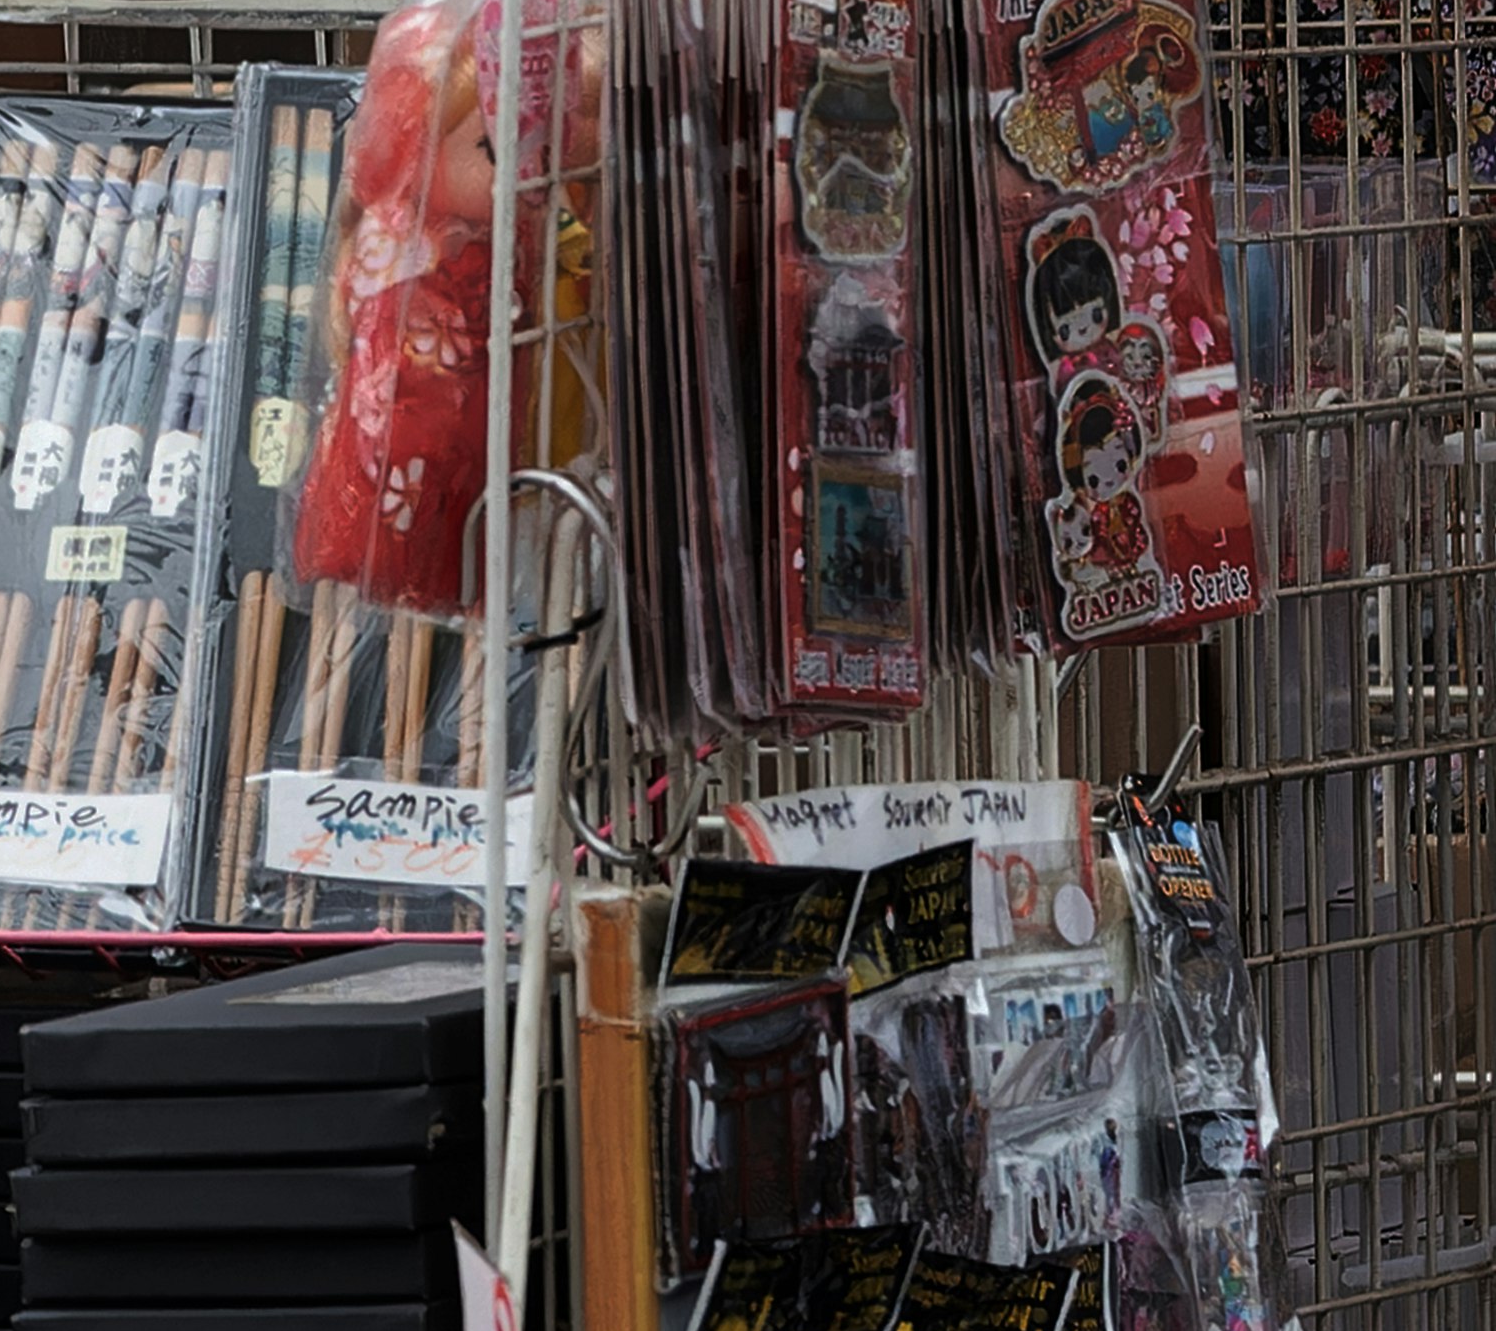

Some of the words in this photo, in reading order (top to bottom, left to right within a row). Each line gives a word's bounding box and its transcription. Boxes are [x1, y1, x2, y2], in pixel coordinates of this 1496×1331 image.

[1071, 577, 1159, 627] JAPAN
[1190, 562, 1253, 611] Series
[961, 788, 1027, 826] JAPAN
